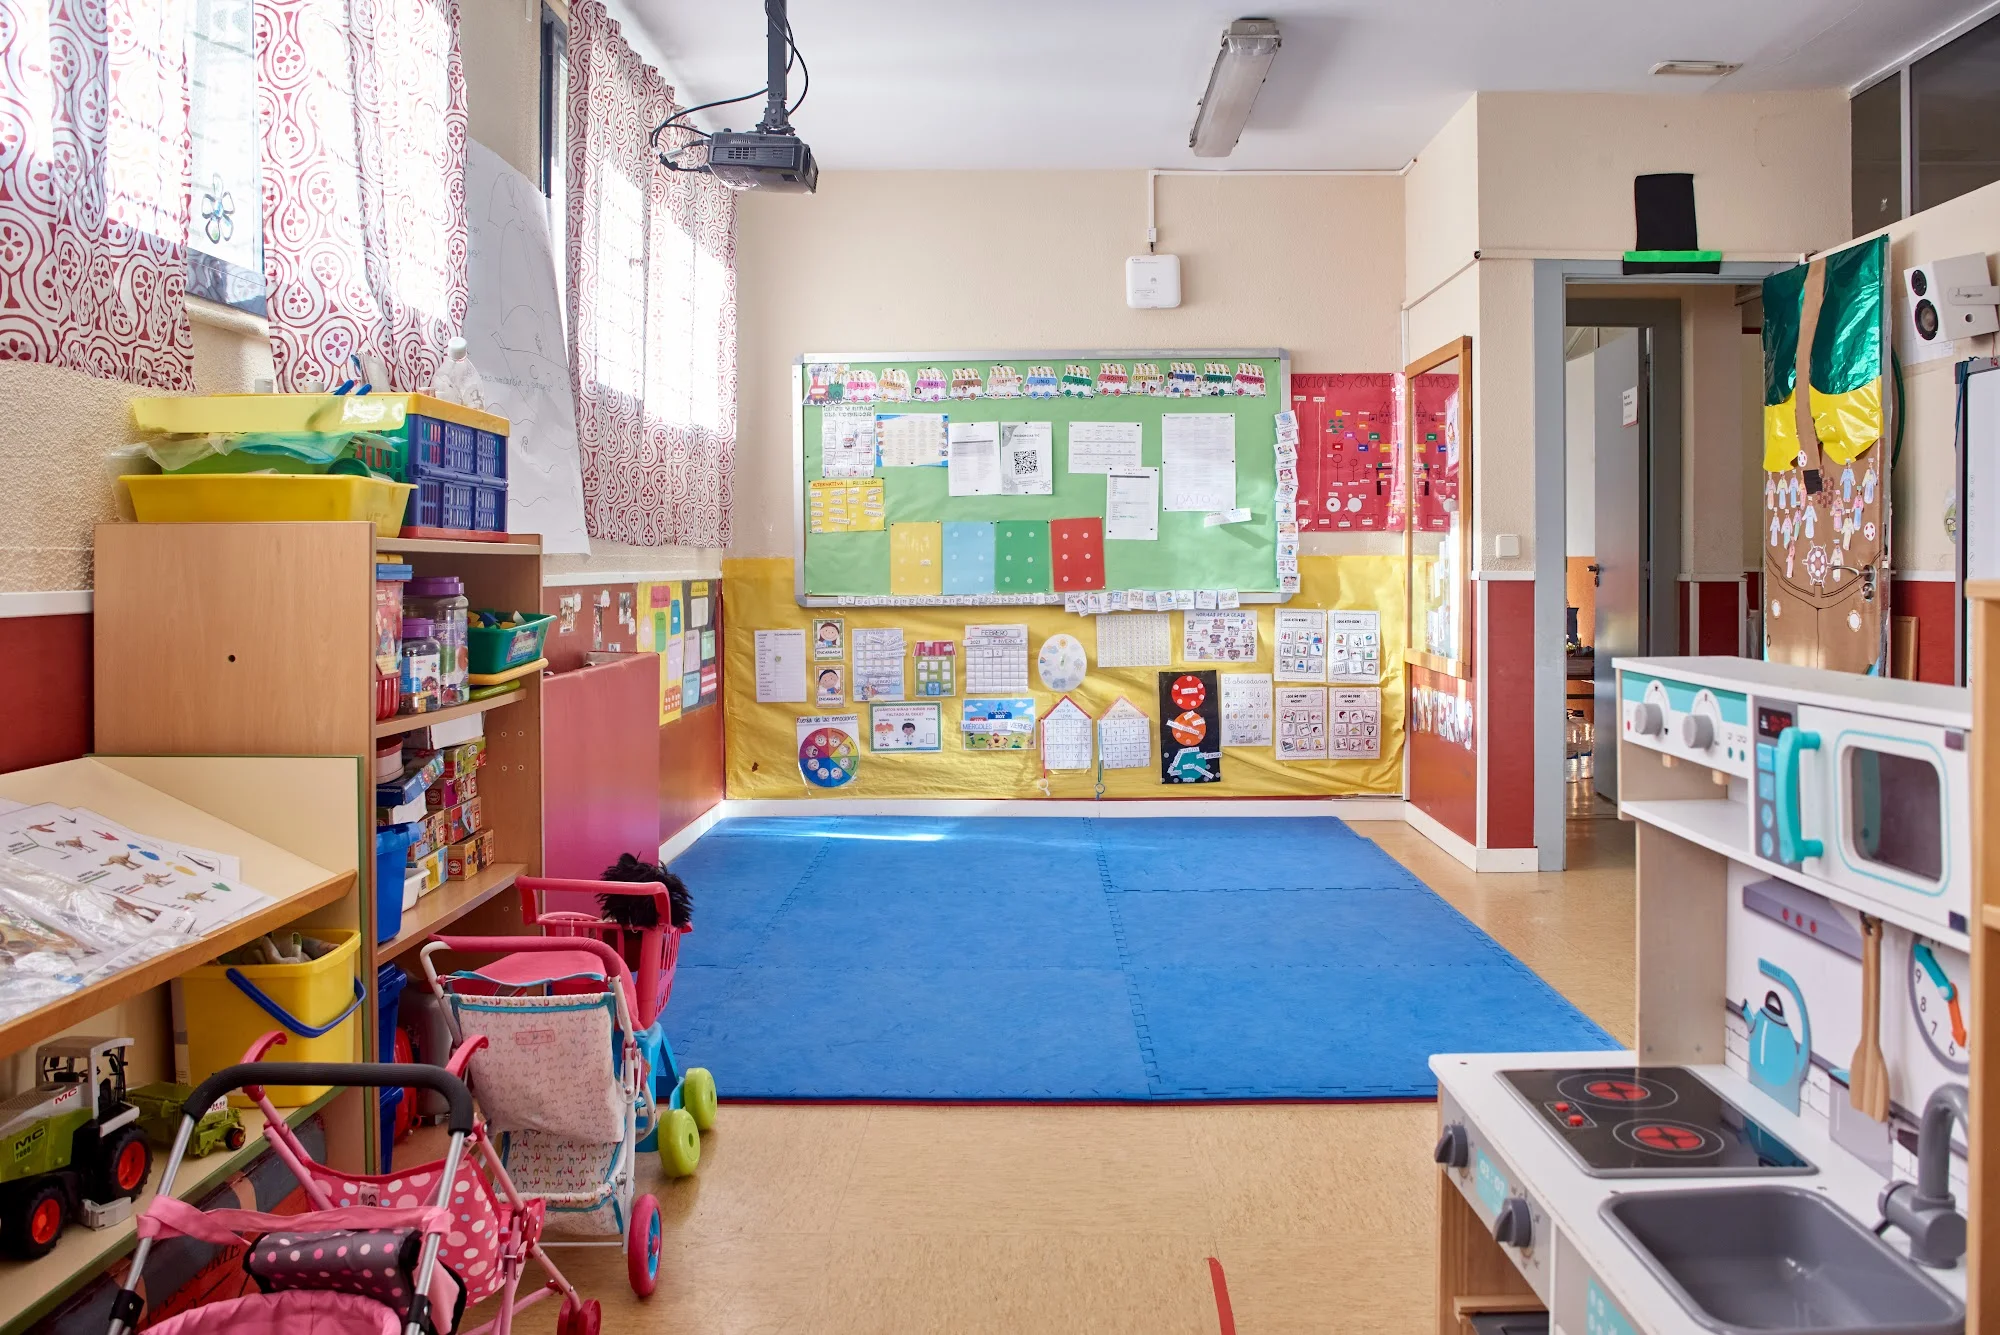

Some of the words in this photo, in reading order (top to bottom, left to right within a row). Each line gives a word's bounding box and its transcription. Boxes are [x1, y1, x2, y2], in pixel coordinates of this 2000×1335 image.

[1291, 376, 1345, 391] NOCIONES
[980, 629, 1009, 637] FEBRERO
[1224, 676, 1231, 685] El
[1232, 676, 1269, 685] abecedario
[962, 722, 993, 731] MIÉRCOLES
[1009, 721, 1032, 732] VIERNES
[1915, 968, 1922, 984] 9
[1919, 996, 1927, 1013] 8
[1931, 1020, 1938, 1036] 7
[1948, 1040, 1955, 1057] 6
[54, 1086, 78, 1105] MC
[15, 1127, 44, 1151] MC
